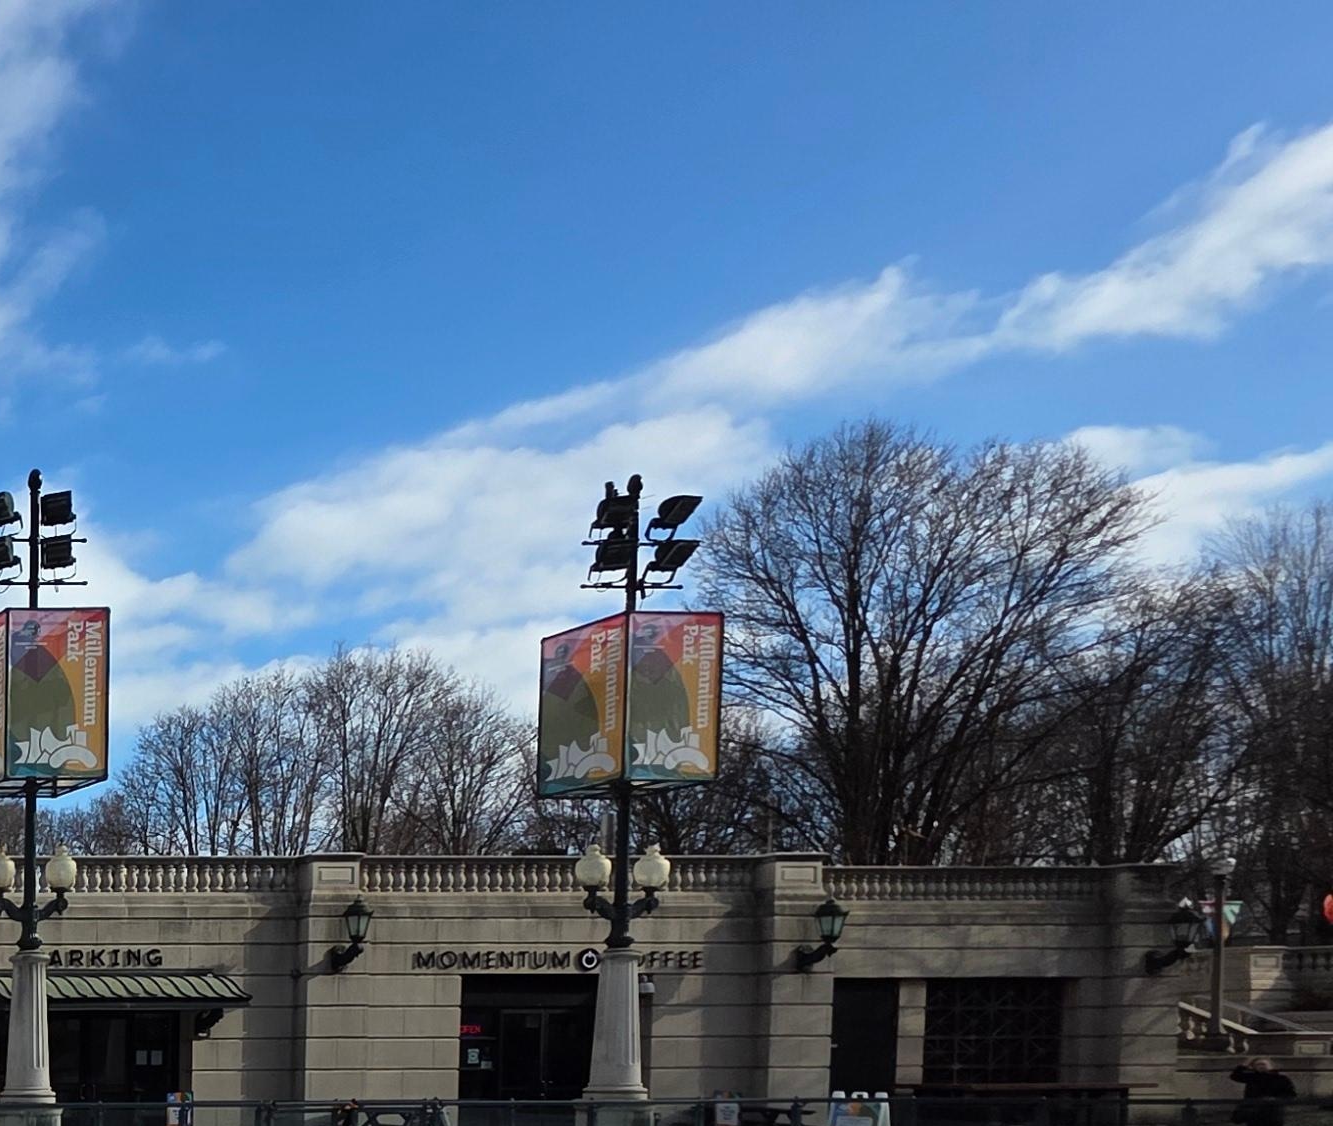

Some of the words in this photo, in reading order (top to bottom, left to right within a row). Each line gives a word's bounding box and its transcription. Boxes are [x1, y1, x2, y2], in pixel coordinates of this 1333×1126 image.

[67, 620, 84, 662] Park
[590, 630, 606, 674] Park
[683, 624, 699, 665] Park
[83, 620, 102, 727] Millennium
[605, 627, 622, 732] Millennium
[697, 624, 716, 729] Millennium
[48, 949, 162, 967] ARKING
[416, 951, 571, 968] MOMENTUM
[638, 951, 703, 968] FFEE
